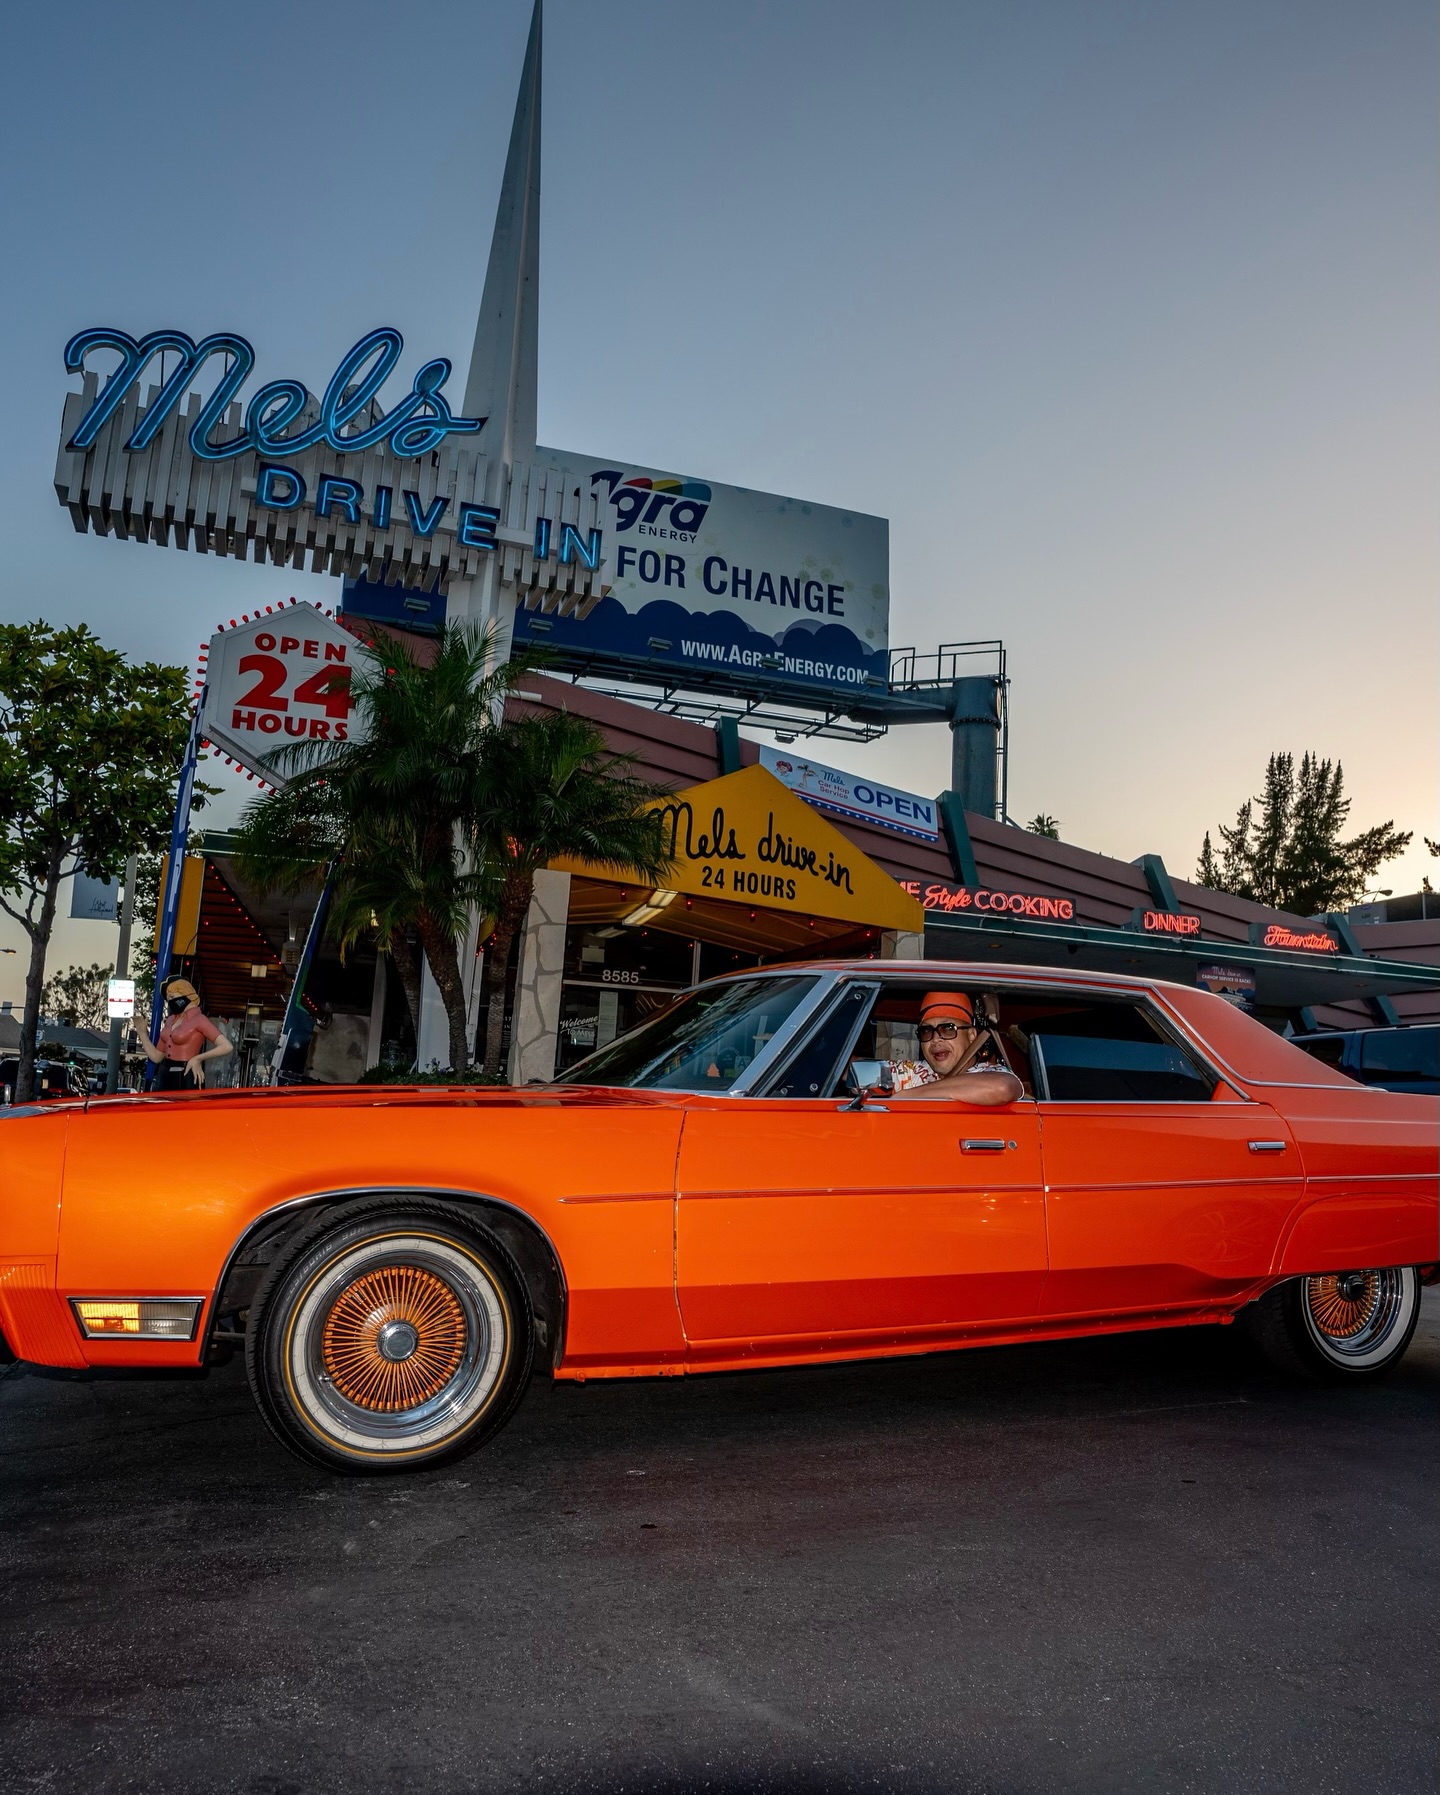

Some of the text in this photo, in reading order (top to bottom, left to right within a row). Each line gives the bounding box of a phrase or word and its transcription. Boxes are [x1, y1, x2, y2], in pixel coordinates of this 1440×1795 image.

[64, 327, 489, 461] Mels
[255, 462, 603, 572] DRIVE IN
[639, 524, 697, 543] ENERGY
[617, 545, 845, 617] FOR CHANGE
[254, 633, 346, 662] OPEN
[234, 654, 356, 719] 24
[231, 709, 348, 741] HOURS
[818, 780, 849, 794] Car Hop
[820, 786, 848, 799] Service
[821, 769, 846, 786] Mels
[854, 785, 932, 824] OPEN
[648, 802, 746, 860] Mels
[758, 812, 854, 895] drive-in
[702, 866, 796, 900] 24 HOURS
[924, 885, 972, 912] Style
[974, 891, 1073, 919] COOKING
[1144, 911, 1199, 934] DINNER
[1264, 925, 1339, 951] Fountain
[602, 969, 639, 984] 8585
[560, 1016, 598, 1029] Welcome
